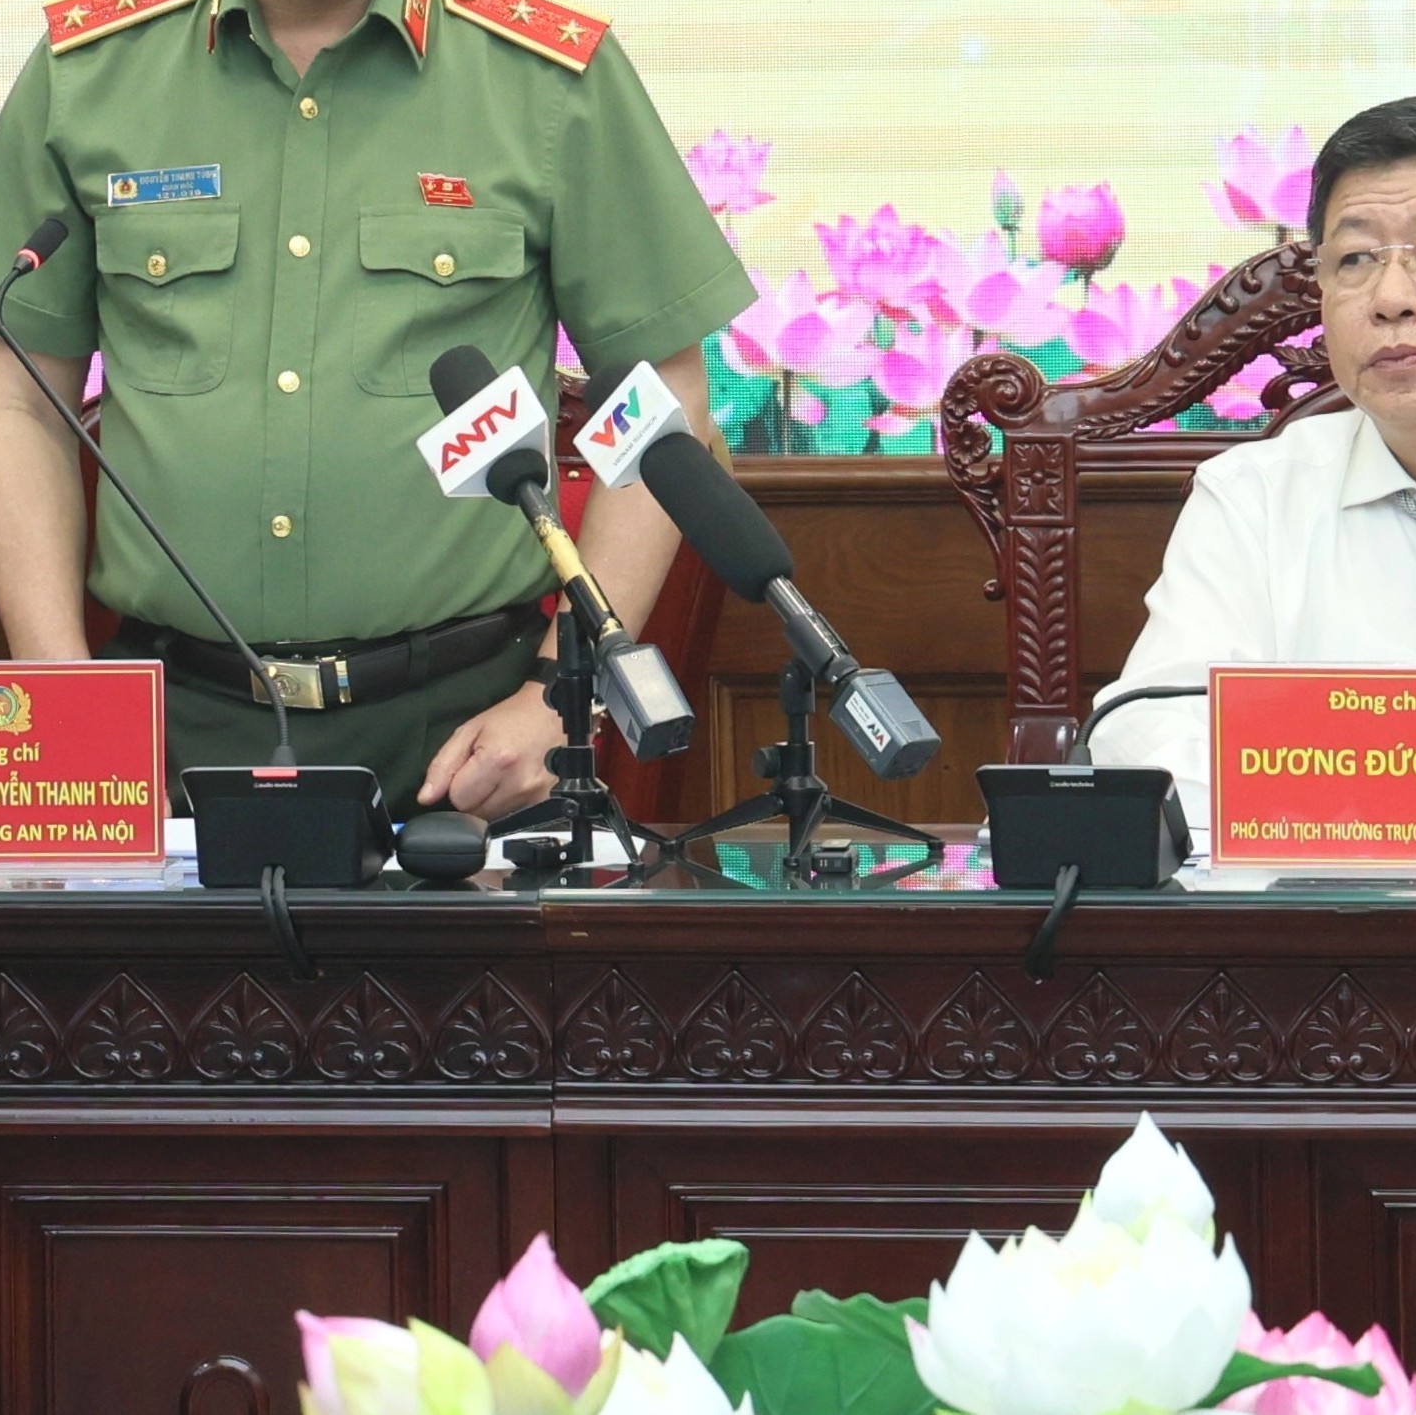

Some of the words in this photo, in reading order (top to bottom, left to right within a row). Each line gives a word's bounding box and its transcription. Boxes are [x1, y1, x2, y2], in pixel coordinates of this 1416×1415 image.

[588, 384, 641, 448] VTV
[440, 388, 518, 475] ANTV
[1328, 687, 1387, 715] Đồng
[13, 742, 40, 762] chí
[1240, 746, 1357, 777] DƯƠNG
[36, 782, 95, 806] THANH
[99, 775, 149, 806] TÙNG
[16, 824, 43, 842] AN
[46, 824, 69, 841] TP
[72, 822, 98, 841] HÀ
[101, 819, 135, 843] NỘI
[1230, 818, 1260, 840] PHÓ
[1260, 817, 1290, 840] CHỦ
[1291, 822, 1322, 842] TỊCH
[1323, 820, 1384, 841] THƯỜNG
